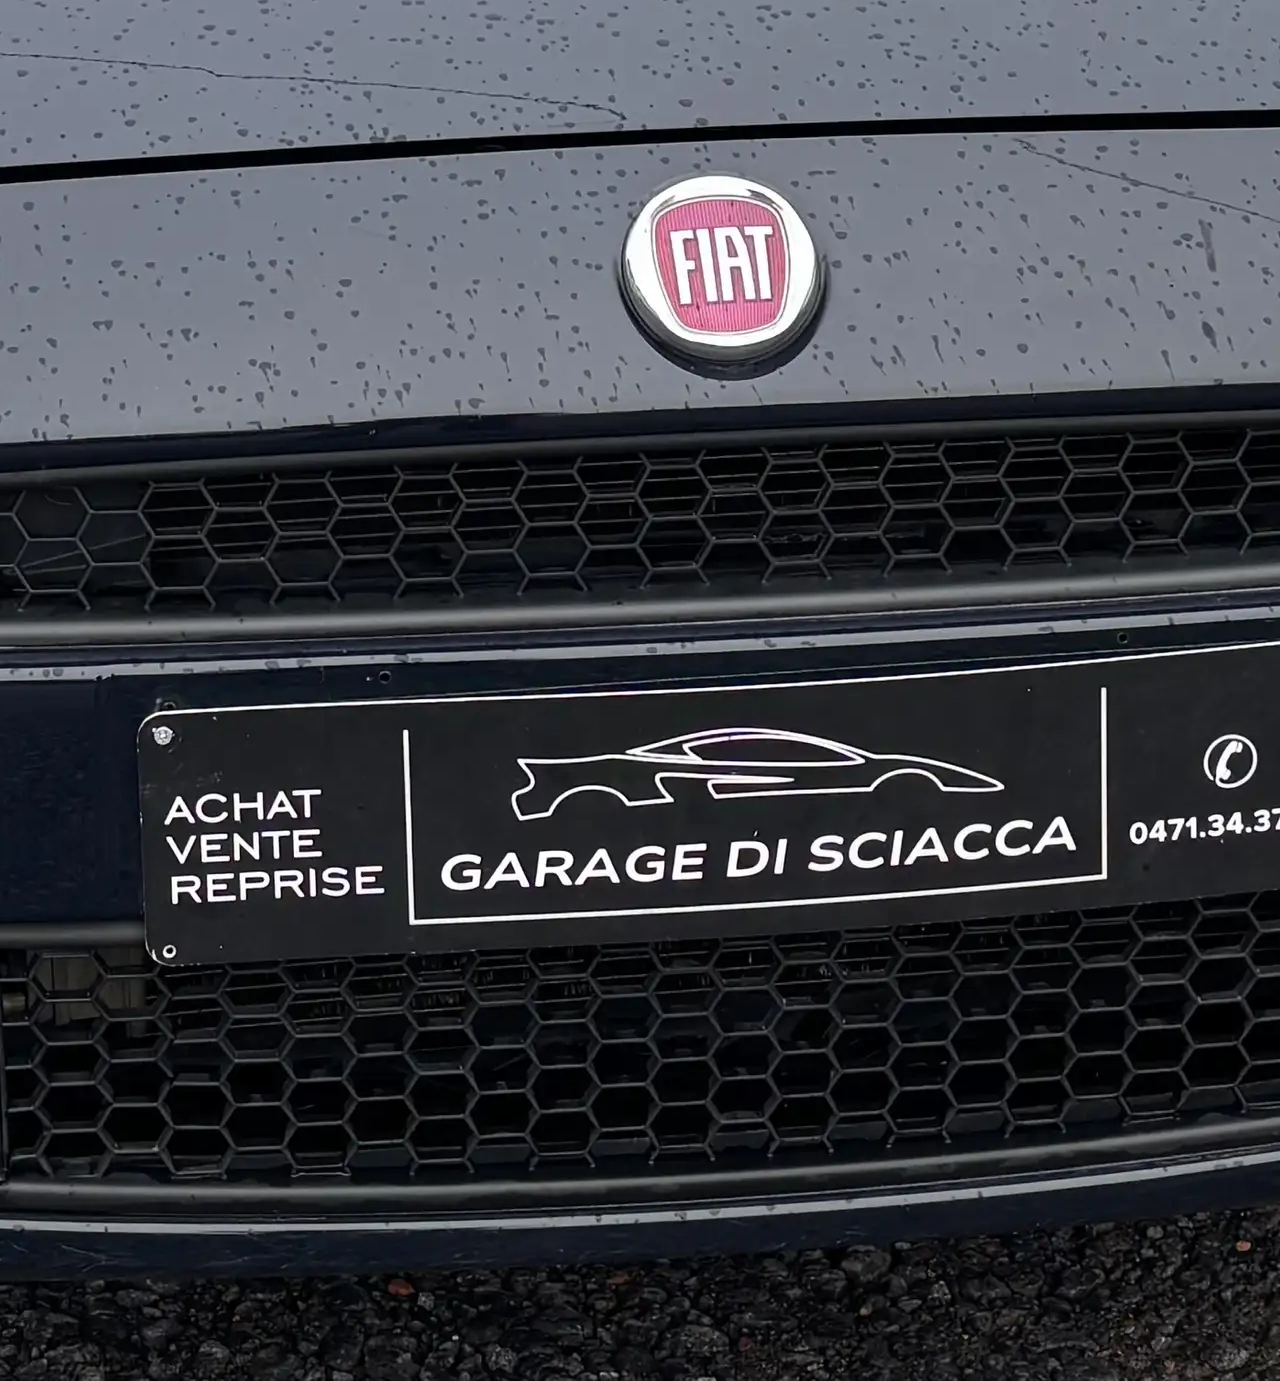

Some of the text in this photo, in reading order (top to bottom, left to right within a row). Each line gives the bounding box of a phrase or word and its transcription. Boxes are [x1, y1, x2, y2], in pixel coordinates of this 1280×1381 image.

[669, 225, 774, 306] FIAT
[163, 789, 323, 826] ACHAT
[165, 828, 323, 865] VENTE
[440, 815, 1078, 892] GARAGE DI SCIACCA
[170, 865, 385, 905] REPRISE
